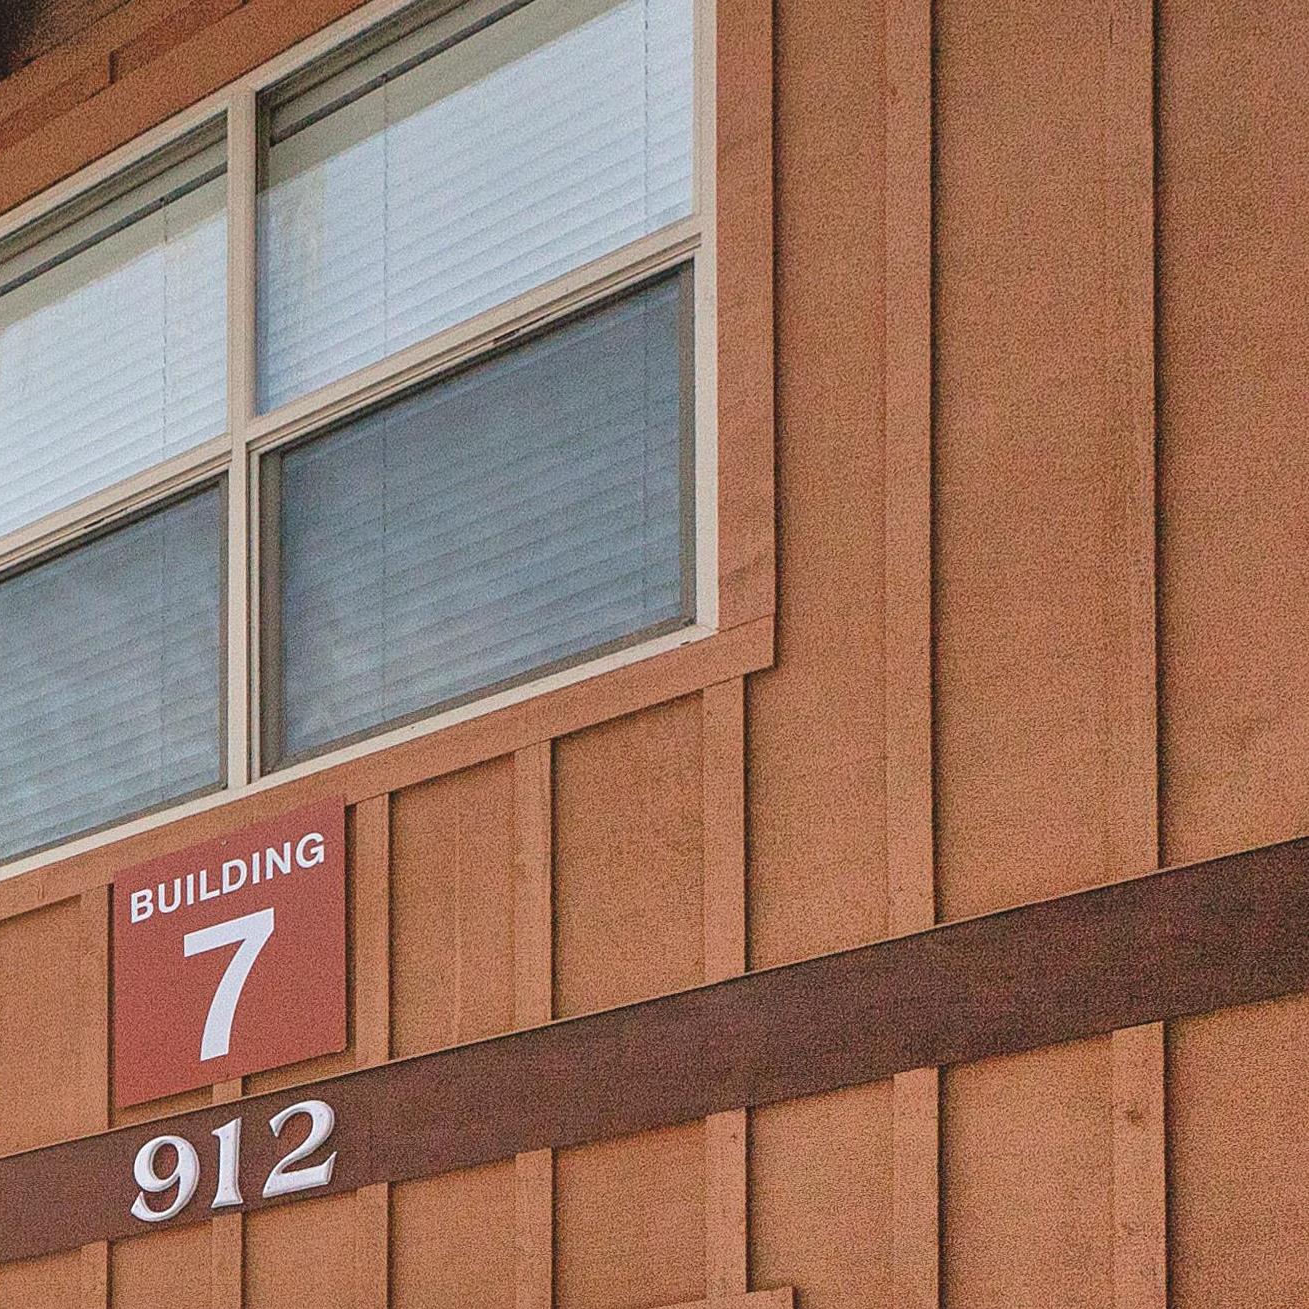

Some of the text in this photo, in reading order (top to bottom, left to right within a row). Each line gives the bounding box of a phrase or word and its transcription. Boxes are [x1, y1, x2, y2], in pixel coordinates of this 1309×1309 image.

[130, 832, 325, 923] BUILDING
[183, 907, 275, 1061] 7
[130, 1099, 337, 1223] 912
